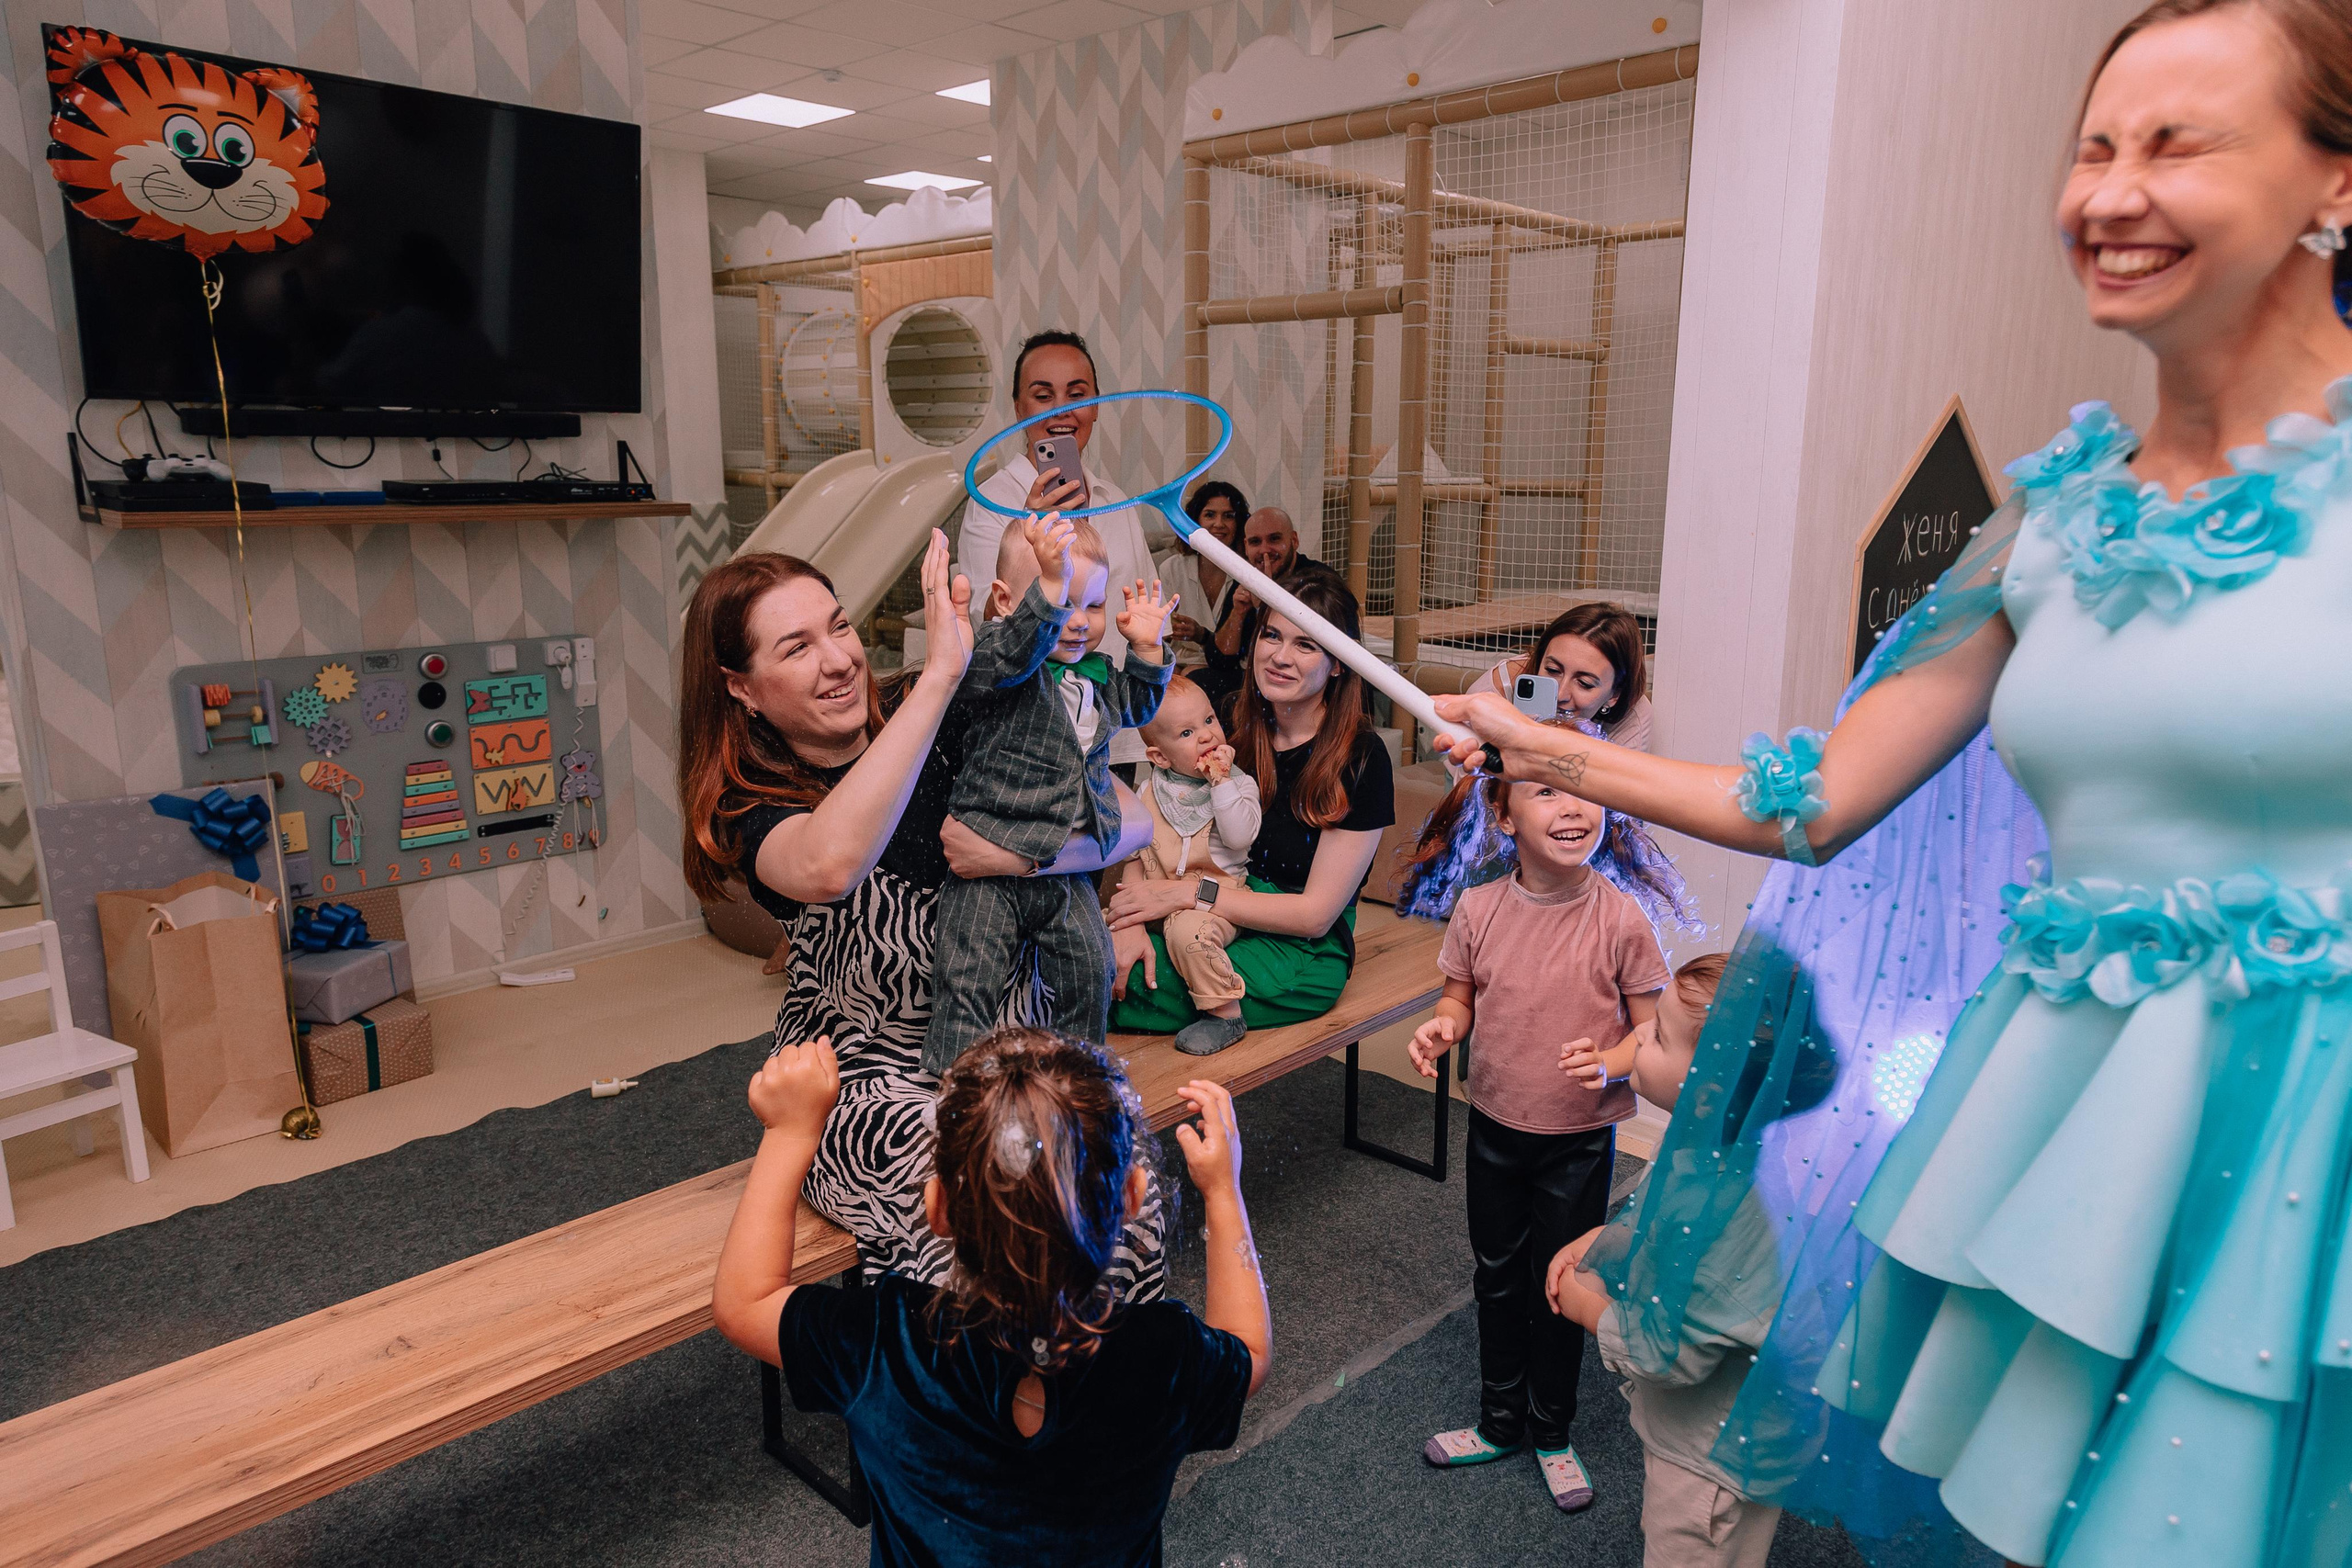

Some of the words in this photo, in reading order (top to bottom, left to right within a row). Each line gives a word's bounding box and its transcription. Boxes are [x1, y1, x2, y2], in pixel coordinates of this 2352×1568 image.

[322, 874, 336, 893] 0
[357, 869, 367, 886] 1
[387, 863, 401, 882] 2
[419, 857, 432, 876] 3
[449, 852, 462, 870] 4
[479, 846, 492, 864] 5
[507, 841, 520, 860] 6
[535, 837, 547, 854] 7
[562, 832, 574, 850] 8
